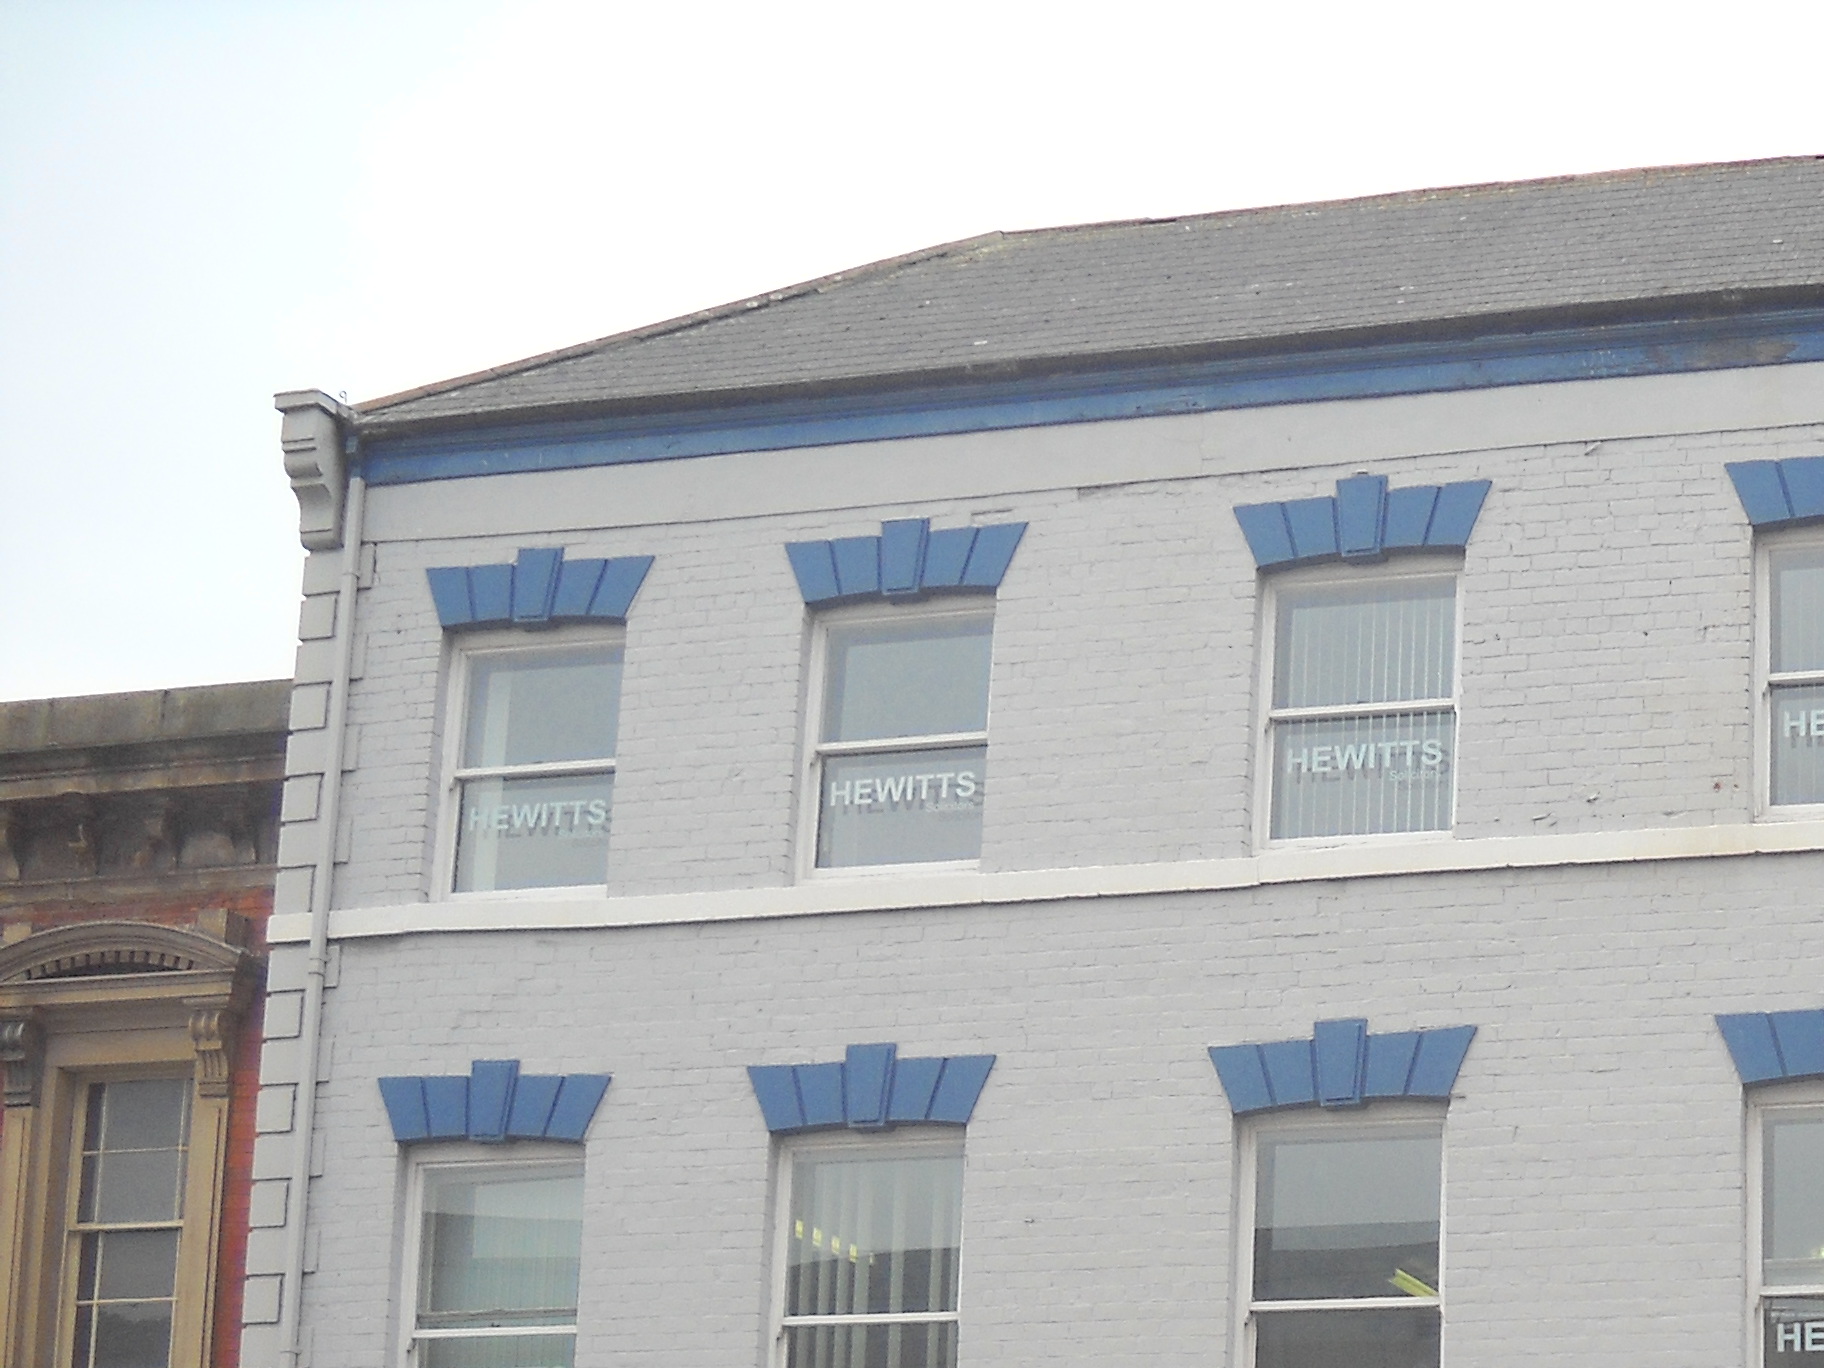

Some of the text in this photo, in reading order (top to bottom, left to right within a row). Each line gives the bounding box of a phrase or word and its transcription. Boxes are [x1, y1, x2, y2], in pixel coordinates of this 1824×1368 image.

[1287, 738, 1444, 774] HEWITTS
[829, 770, 976, 807] HEWITTS
[468, 798, 607, 832] HEWITTS
